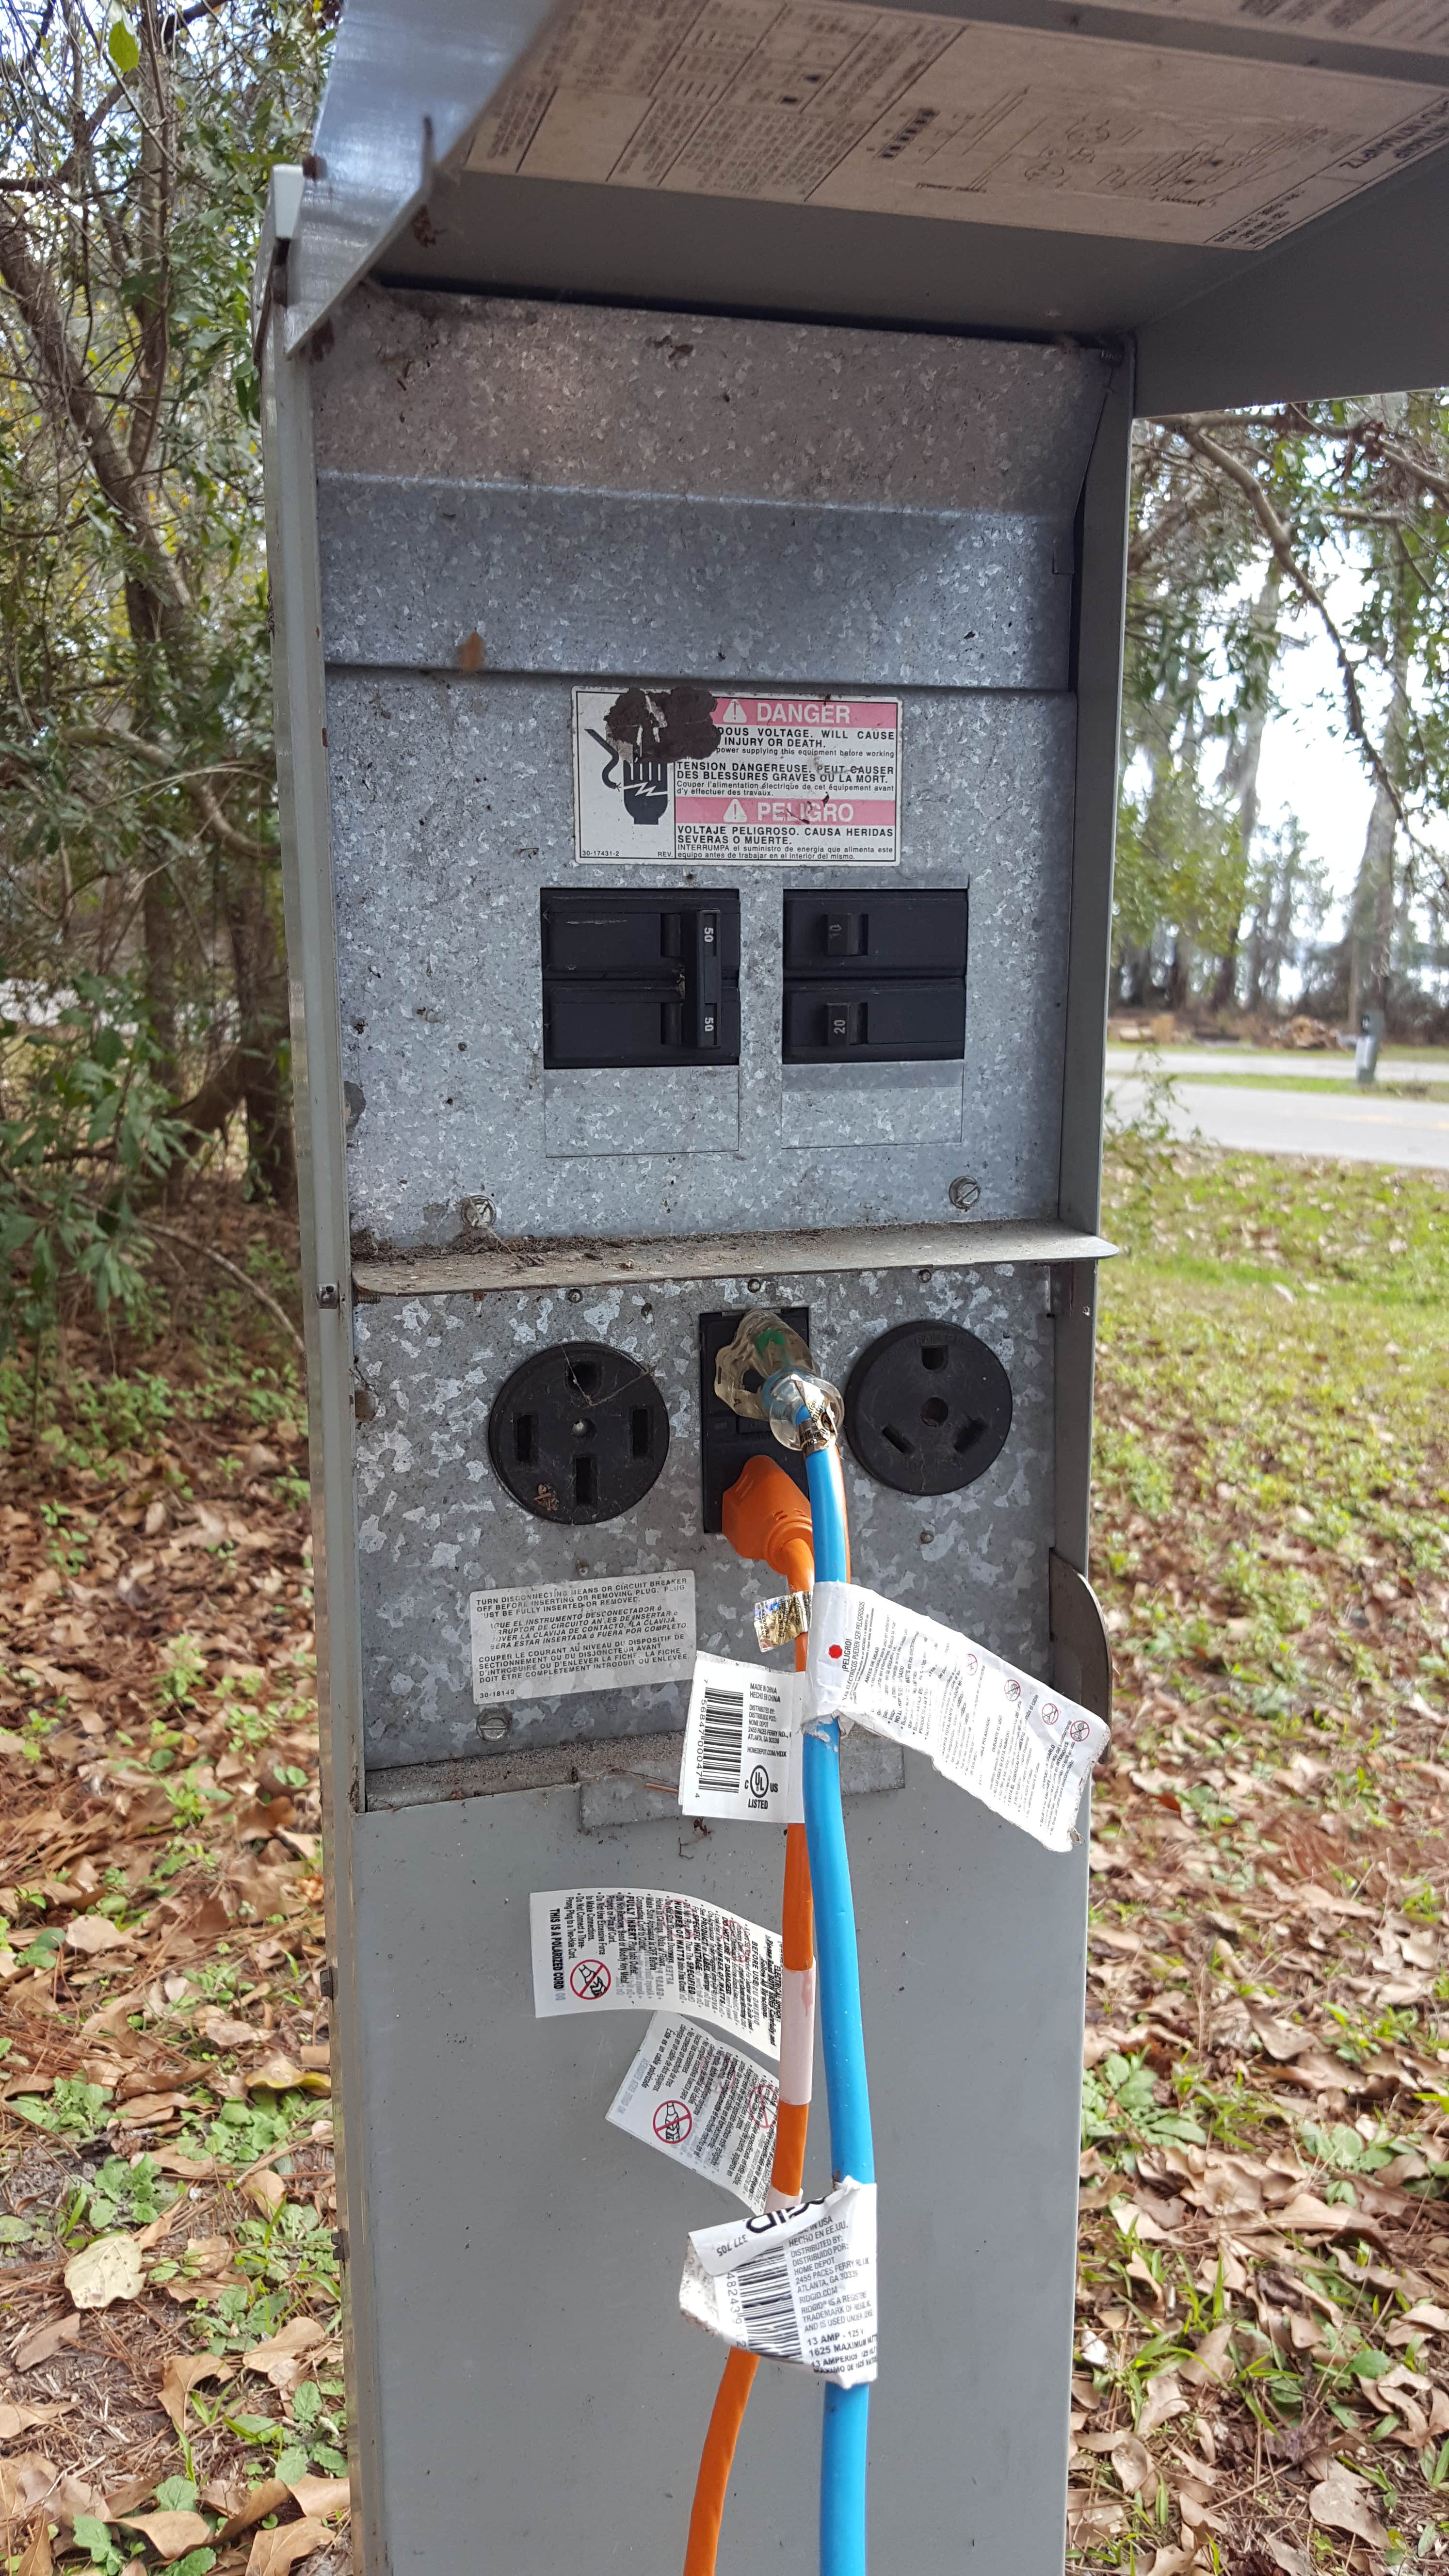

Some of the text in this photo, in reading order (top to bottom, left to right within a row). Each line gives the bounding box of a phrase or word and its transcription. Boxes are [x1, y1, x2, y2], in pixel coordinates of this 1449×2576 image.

[757, 702, 850, 724] DANGER
[718, 727, 895, 741] DOUS VOLTAGE. WILL CAUSE
[724, 736, 825, 748] INJURY OR DEATH.
[741, 747, 778, 756] supplying
[781, 747, 795, 756] this
[797, 748, 836, 757] equipment
[839, 748, 863, 758] before
[866, 749, 896, 758] working
[676, 761, 894, 774] TENSION DANGEREUSE. PEUT CAUSER
[676, 770, 887, 783] DES BLESSURES GRAVES OU LA MORT.
[676, 780, 704, 789] Couper
[707, 780, 759, 790] l'alimentation
[759, 781, 799, 790] électrique
[828, 783, 871, 792] équipement
[676, 787, 688, 796] d'y
[757, 803, 853, 823] PELIGRO
[677, 825, 893, 837] VOLTAJE PELIGROSO. CAUSA HERIDAS
[677, 834, 791, 845] SEVERAS O MUERTE.
[704, 927, 714, 942] 50
[705, 1017, 714, 1032] 50
[834, 1019, 846, 1034] 20
[501, 1592, 567, 1603] DISCONNECTING
[615, 1581, 647, 1591] CIRCUIT
[650, 1578, 686, 1587] BREAKER
[531, 1596, 574, 1606] INSERTING
[591, 1590, 632, 1600] REMOVING
[852, 1640, 860, 1659] PUEDEN
[856, 1601, 865, 1629] PELIGROSOS
[528, 1647, 567, 1657] COURANT
[582, 1642, 612, 1651] NIVEAU
[628, 1635, 671, 1645] DISPOSITIF
[479, 1656, 547, 1670] SECTIONNEMENT
[578, 1646, 634, 1658] DISJONCTEUR
[636, 1642, 661, 1651] AVANT
[842, 1639, 852, 1673] ¡PELIGRO!
[750, 1683, 762, 1691] MADE
[766, 1686, 777, 1694] CHINA
[750, 1691, 763, 1700] HECHO
[698, 1699, 707, 1737] 56847
[696, 1740, 704, 1777] 00047
[747, 1746, 787, 1757] HOMEDEPOT.COM/HDX
[770, 1783, 778, 1792] US
[748, 1799, 768, 1809] LISTED
[596, 1901, 605, 1910] Not
[549, 1908, 561, 1923] THIS
[596, 1910, 605, 1919] Use
[596, 1919, 606, 1942] Excessive
[551, 1936, 563, 1971] POLARIZED
[598, 1942, 607, 1955] Force
[553, 1971, 564, 1989] CORD
[664, 2028, 674, 2039] Éste
[652, 2053, 663, 2065] cable
[641, 2064, 658, 2088] polarizado
[788, 2221, 848, 2247] HECHO EN EE.UU.
[716, 2234, 748, 2256] 377 705
[794, 2256, 835, 2275] HOME DEPOT
[795, 2275, 812, 2285] 2455
[813, 2267, 834, 2279] PACES
[835, 2260, 854, 2272] FERRY
[797, 2279, 829, 2293] ATLANTA,
[839, 2270, 858, 2280] 30339
[799, 2287, 838, 2303] RIDGID.COM
[807, 2337, 818, 2346] 13
[821, 2333, 840, 2343] AMP
[848, 2329, 859, 2337] 125
[809, 2340, 867, 2357] 1625 MAXIMUM
